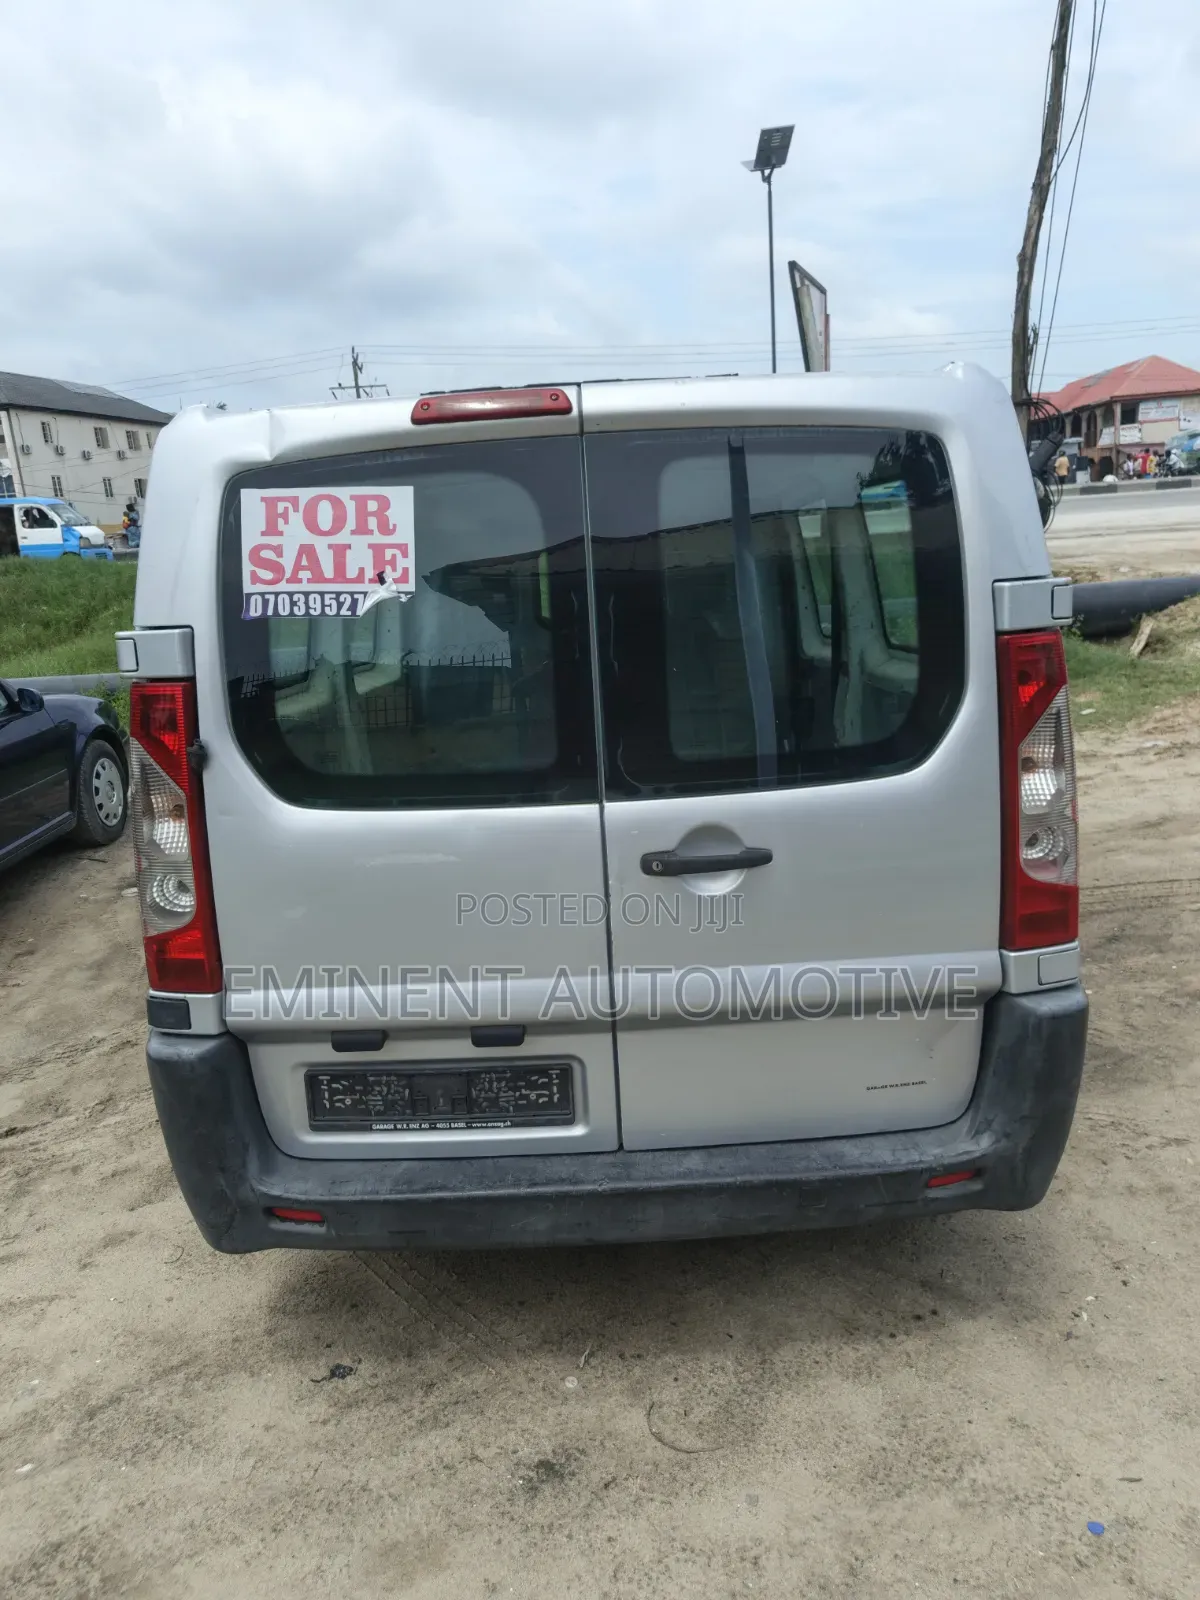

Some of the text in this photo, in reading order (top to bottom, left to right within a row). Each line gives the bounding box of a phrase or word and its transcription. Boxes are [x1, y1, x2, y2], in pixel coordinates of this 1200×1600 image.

[260, 493, 397, 537] FOR
[248, 543, 409, 586] SALE
[249, 593, 365, 616] 07039527
